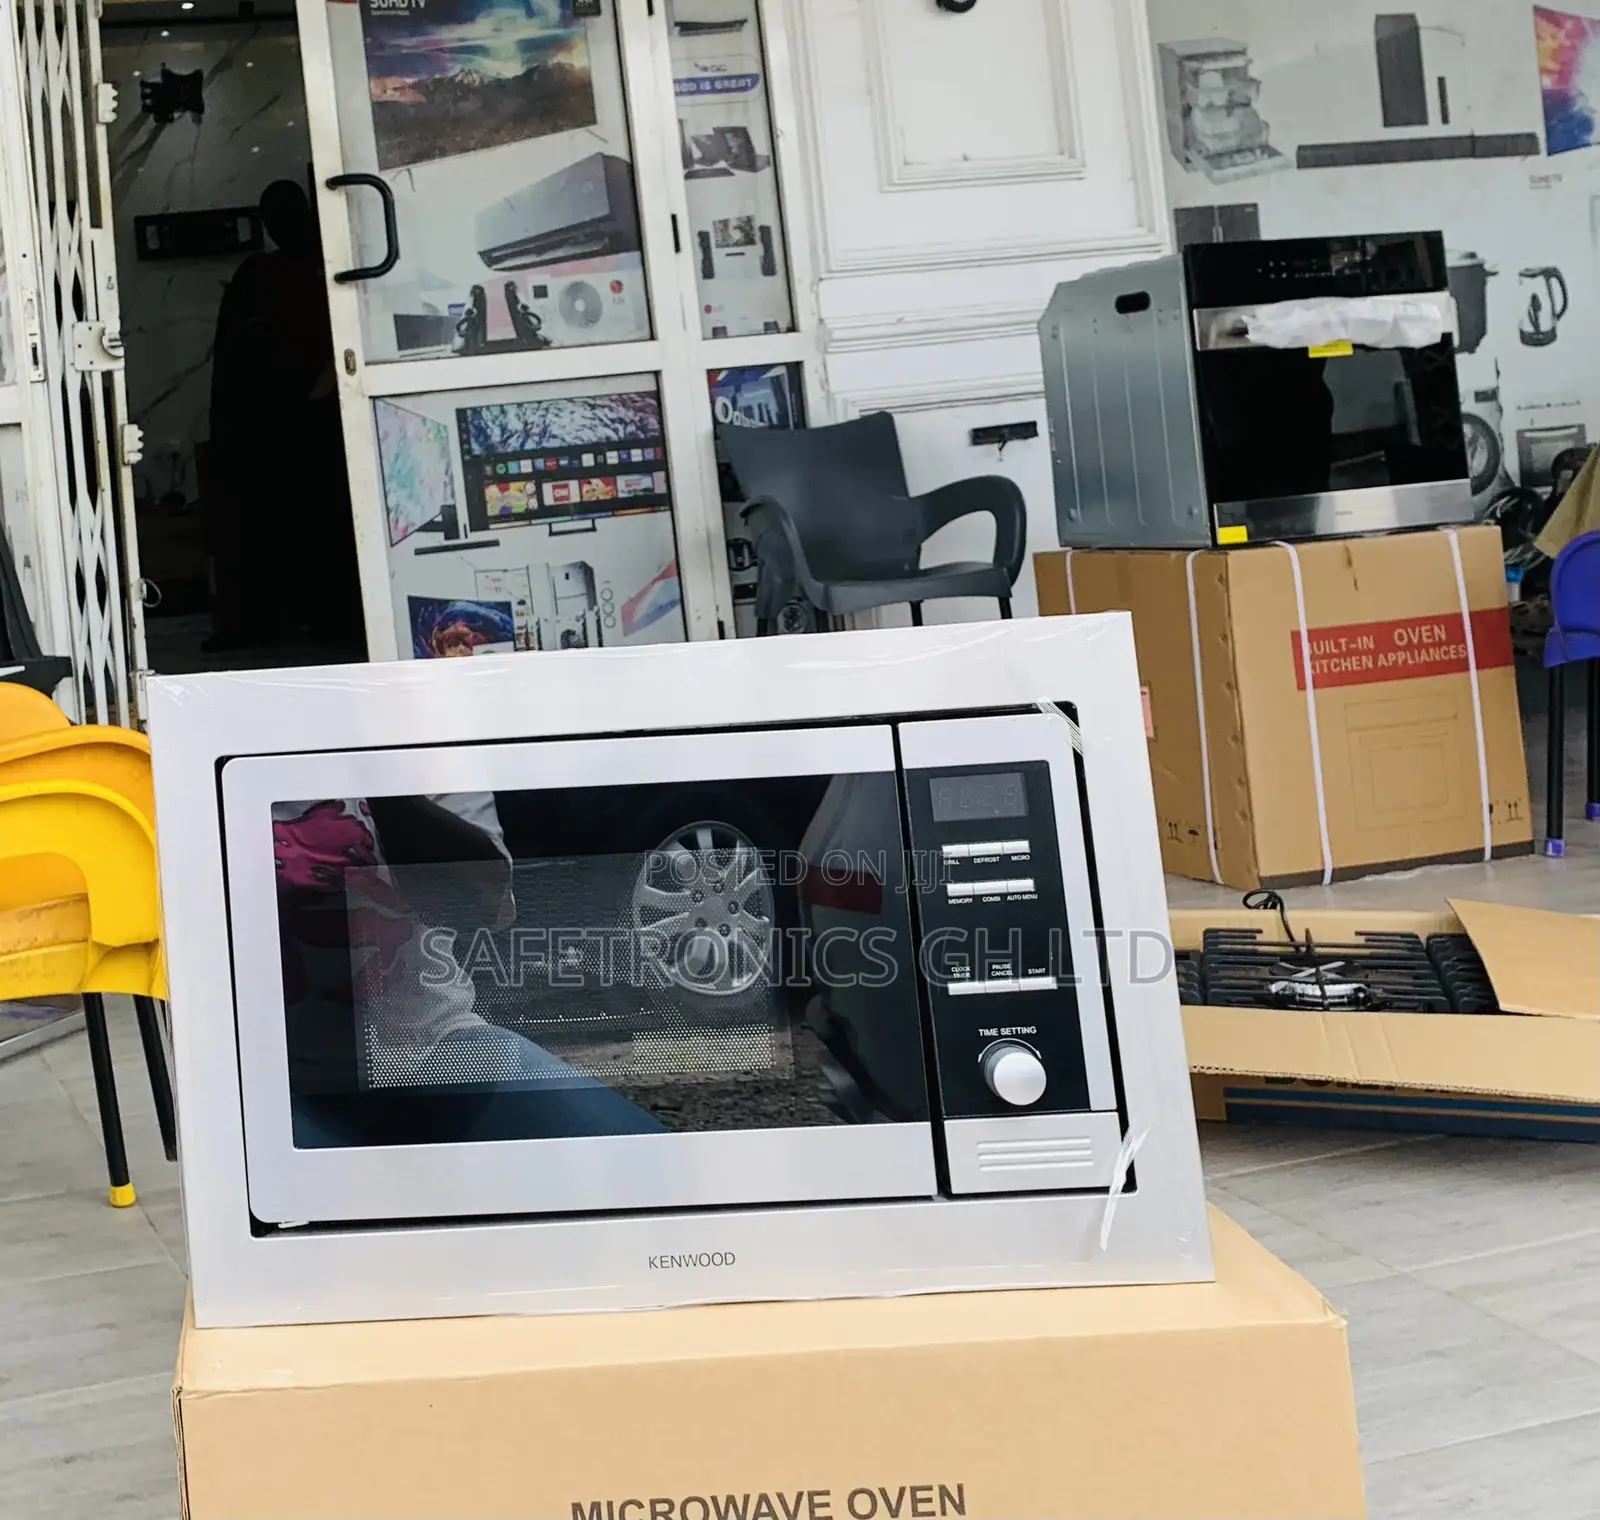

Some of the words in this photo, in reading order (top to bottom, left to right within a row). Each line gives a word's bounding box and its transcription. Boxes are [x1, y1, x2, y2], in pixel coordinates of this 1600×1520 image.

[1393, 624, 1447, 646] OVEN
[1377, 644, 1467, 668] APPLIANCES
[973, 856, 1000, 864] DEFROST
[948, 897, 973, 905] MEMORY
[1027, 967, 1046, 975] START
[978, 1028, 999, 1037] TIME
[1000, 1026, 1037, 1036] SETTING
[648, 1252, 736, 1270] KENWOOD
[571, 1490, 833, 1520] MICROWAVE
[847, 1483, 966, 1520] OVEN
